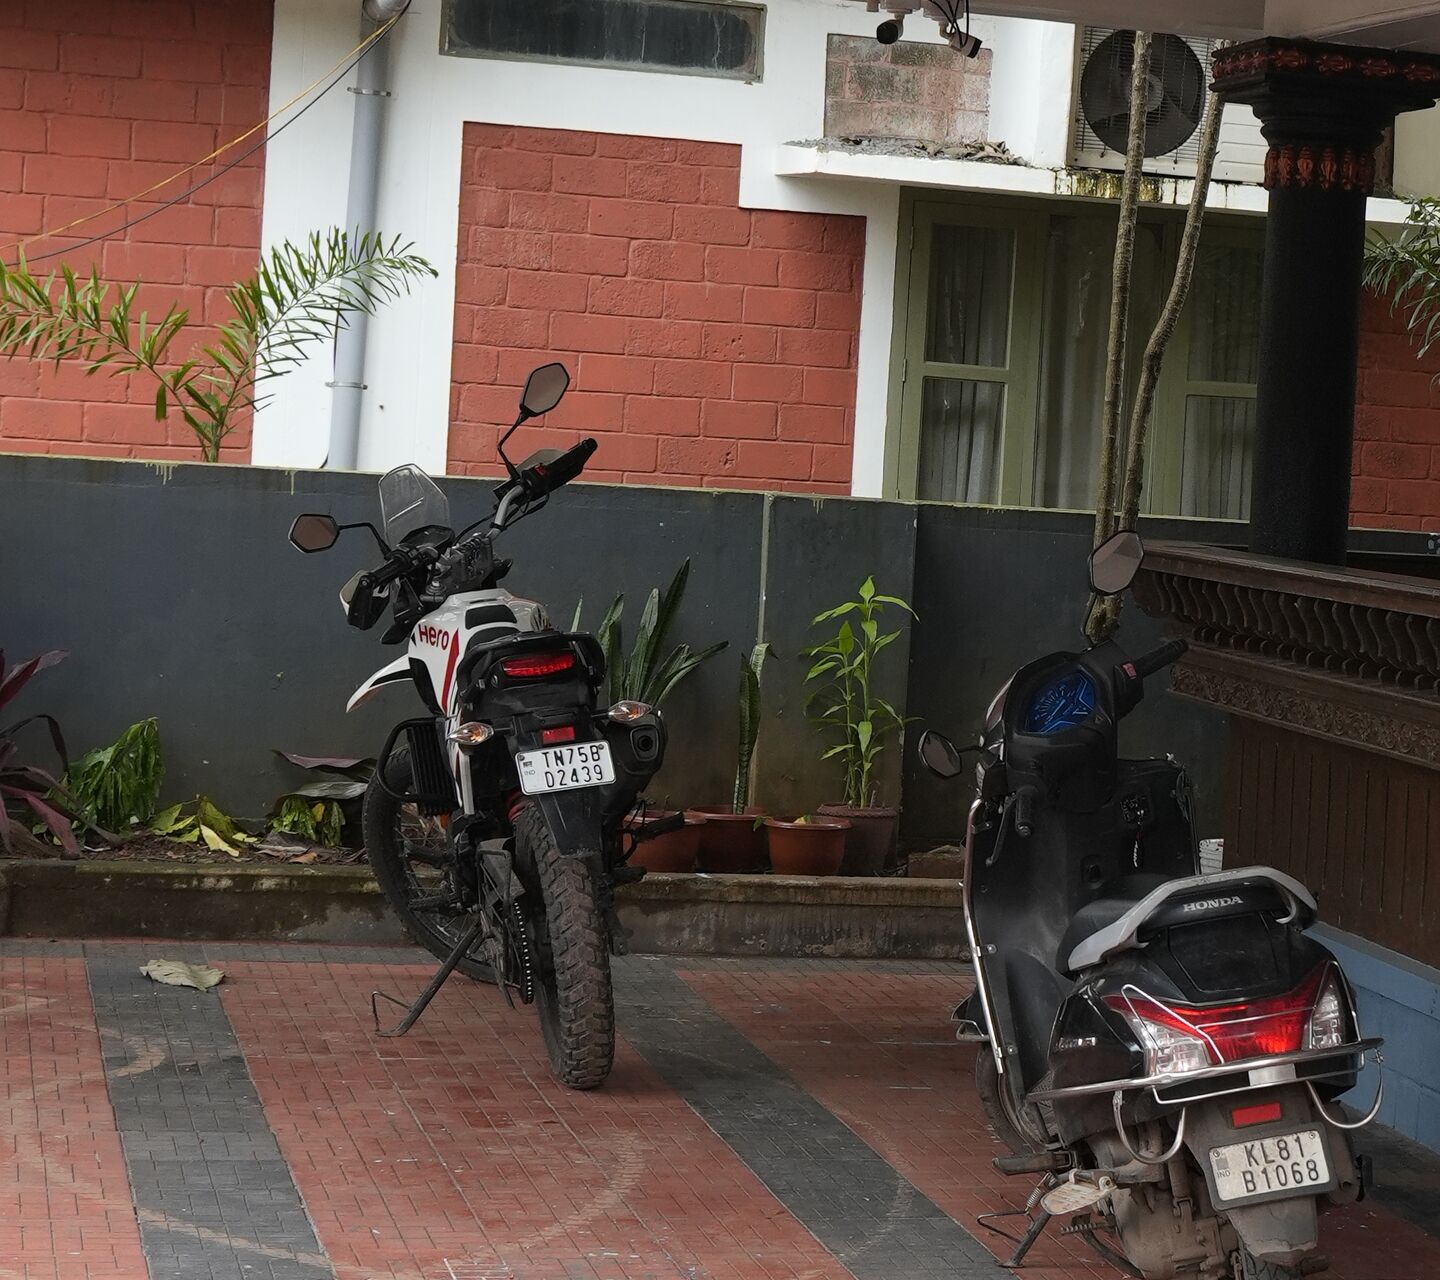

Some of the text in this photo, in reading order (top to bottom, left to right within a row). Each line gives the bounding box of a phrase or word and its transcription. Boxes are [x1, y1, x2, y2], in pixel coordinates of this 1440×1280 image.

[418, 623, 449, 651] Hero
[541, 744, 601, 769] TN75B
[1183, 896, 1244, 912] HONDA
[1244, 1135, 1305, 1168] KL81
[1216, 1170, 1231, 1179] IND
[1241, 1159, 1320, 1193] B1068
